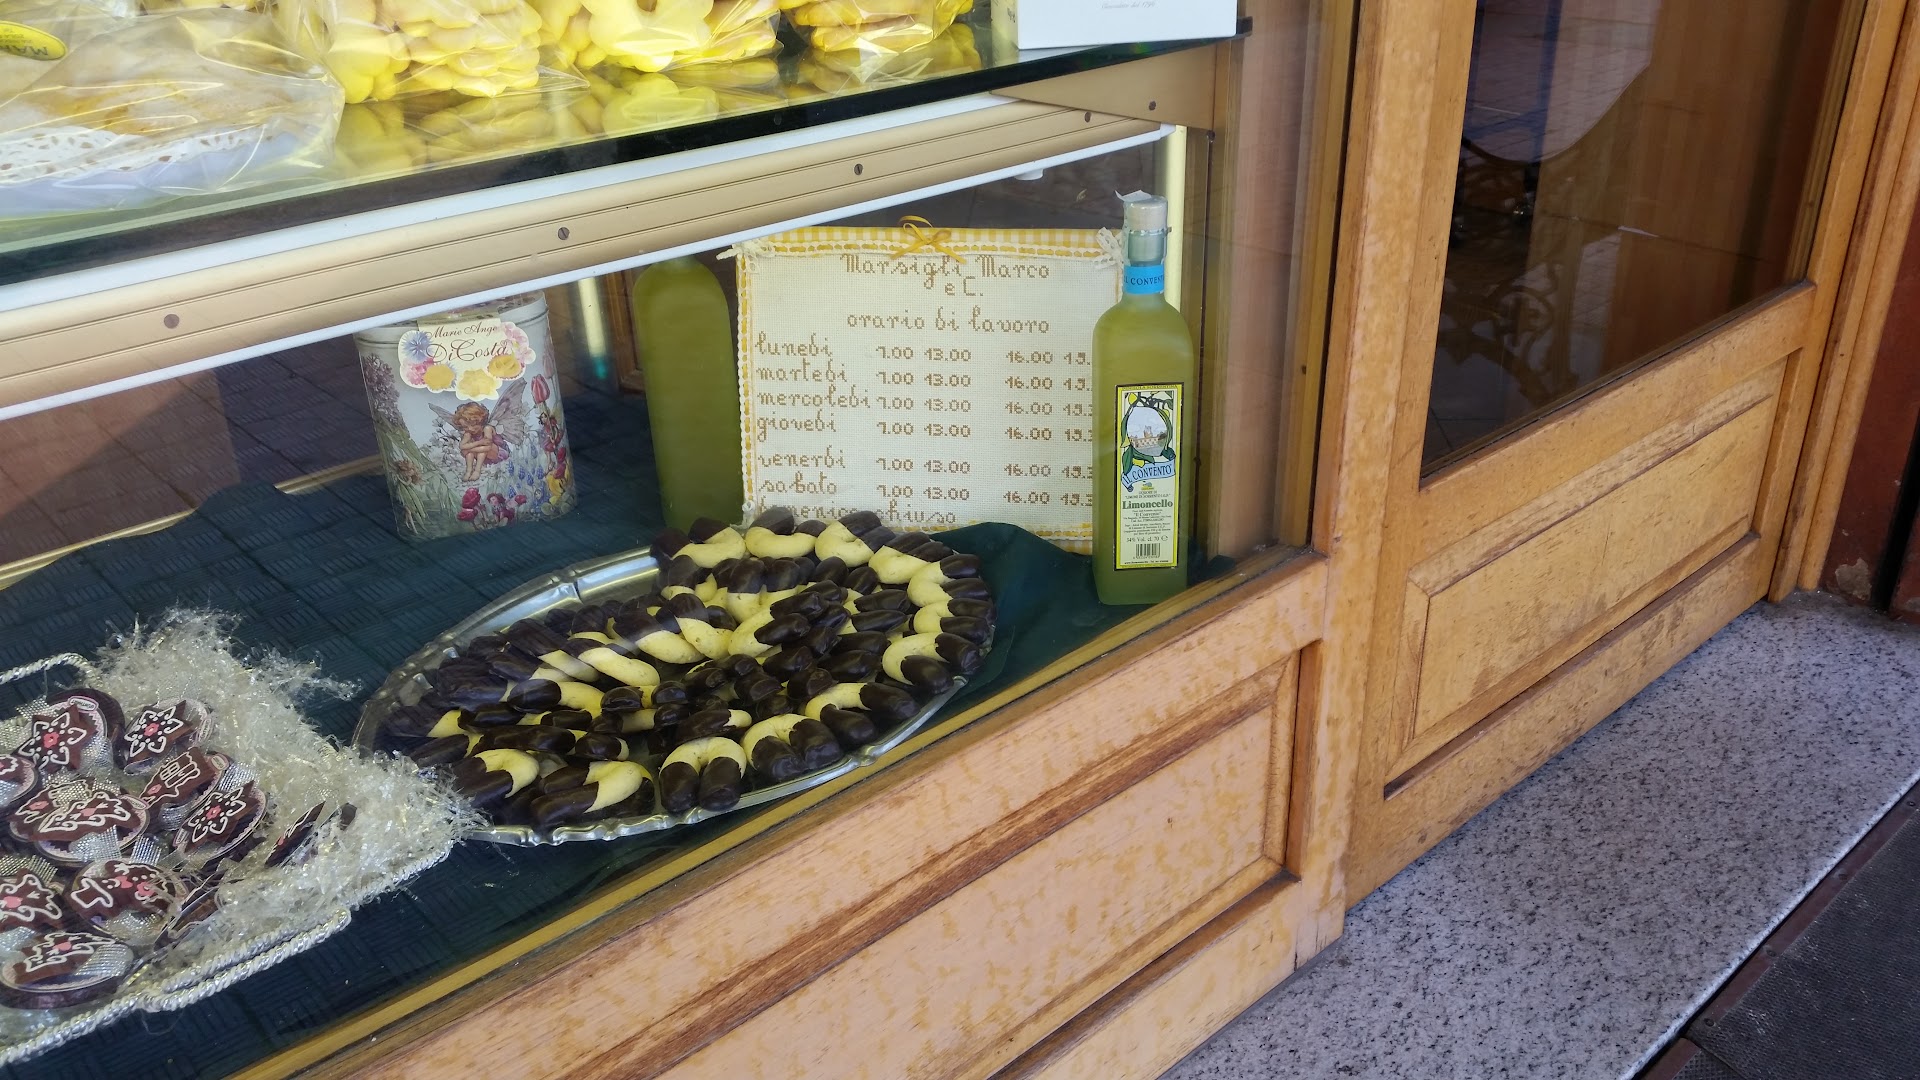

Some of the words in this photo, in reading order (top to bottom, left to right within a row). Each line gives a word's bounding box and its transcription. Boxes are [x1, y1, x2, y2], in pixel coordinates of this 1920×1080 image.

[840, 253, 962, 289] Marsigli
[975, 254, 1050, 278] Marco
[944, 282, 956, 296] e
[963, 275, 983, 296] C.
[427, 325, 462, 339] Marie
[847, 309, 925, 330] orario
[935, 306, 959, 331] di
[968, 305, 1050, 333] lavoro
[755, 330, 833, 357] lunedi
[876, 346, 913, 360] 7.00
[924, 347, 971, 362] 13.00
[1005, 350, 1053, 365] 16.00
[756, 358, 847, 382] martedi
[876, 371, 914, 385] 7.00
[924, 373, 971, 387] 13.00
[1005, 375, 1052, 390] 16.00
[757, 384, 871, 408] mercoledi
[877, 397, 913, 410] 7.00
[924, 398, 971, 412] 13.00
[1005, 402, 1052, 415] 16.00
[757, 409, 837, 443] giovedi
[877, 422, 914, 435] 7.00
[924, 423, 971, 438] 13.00
[1005, 426, 1052, 440] 16.00
[758, 445, 846, 468] venerdi
[876, 457, 913, 471] 7.00
[923, 459, 971, 474] 13.00
[1004, 463, 1051, 478] 16.00
[758, 471, 837, 495] sabato
[876, 484, 913, 498] 7.00
[923, 486, 970, 501] 13.00
[1003, 490, 1050, 505] 16.00
[1122, 499, 1173, 510] Limoncello
